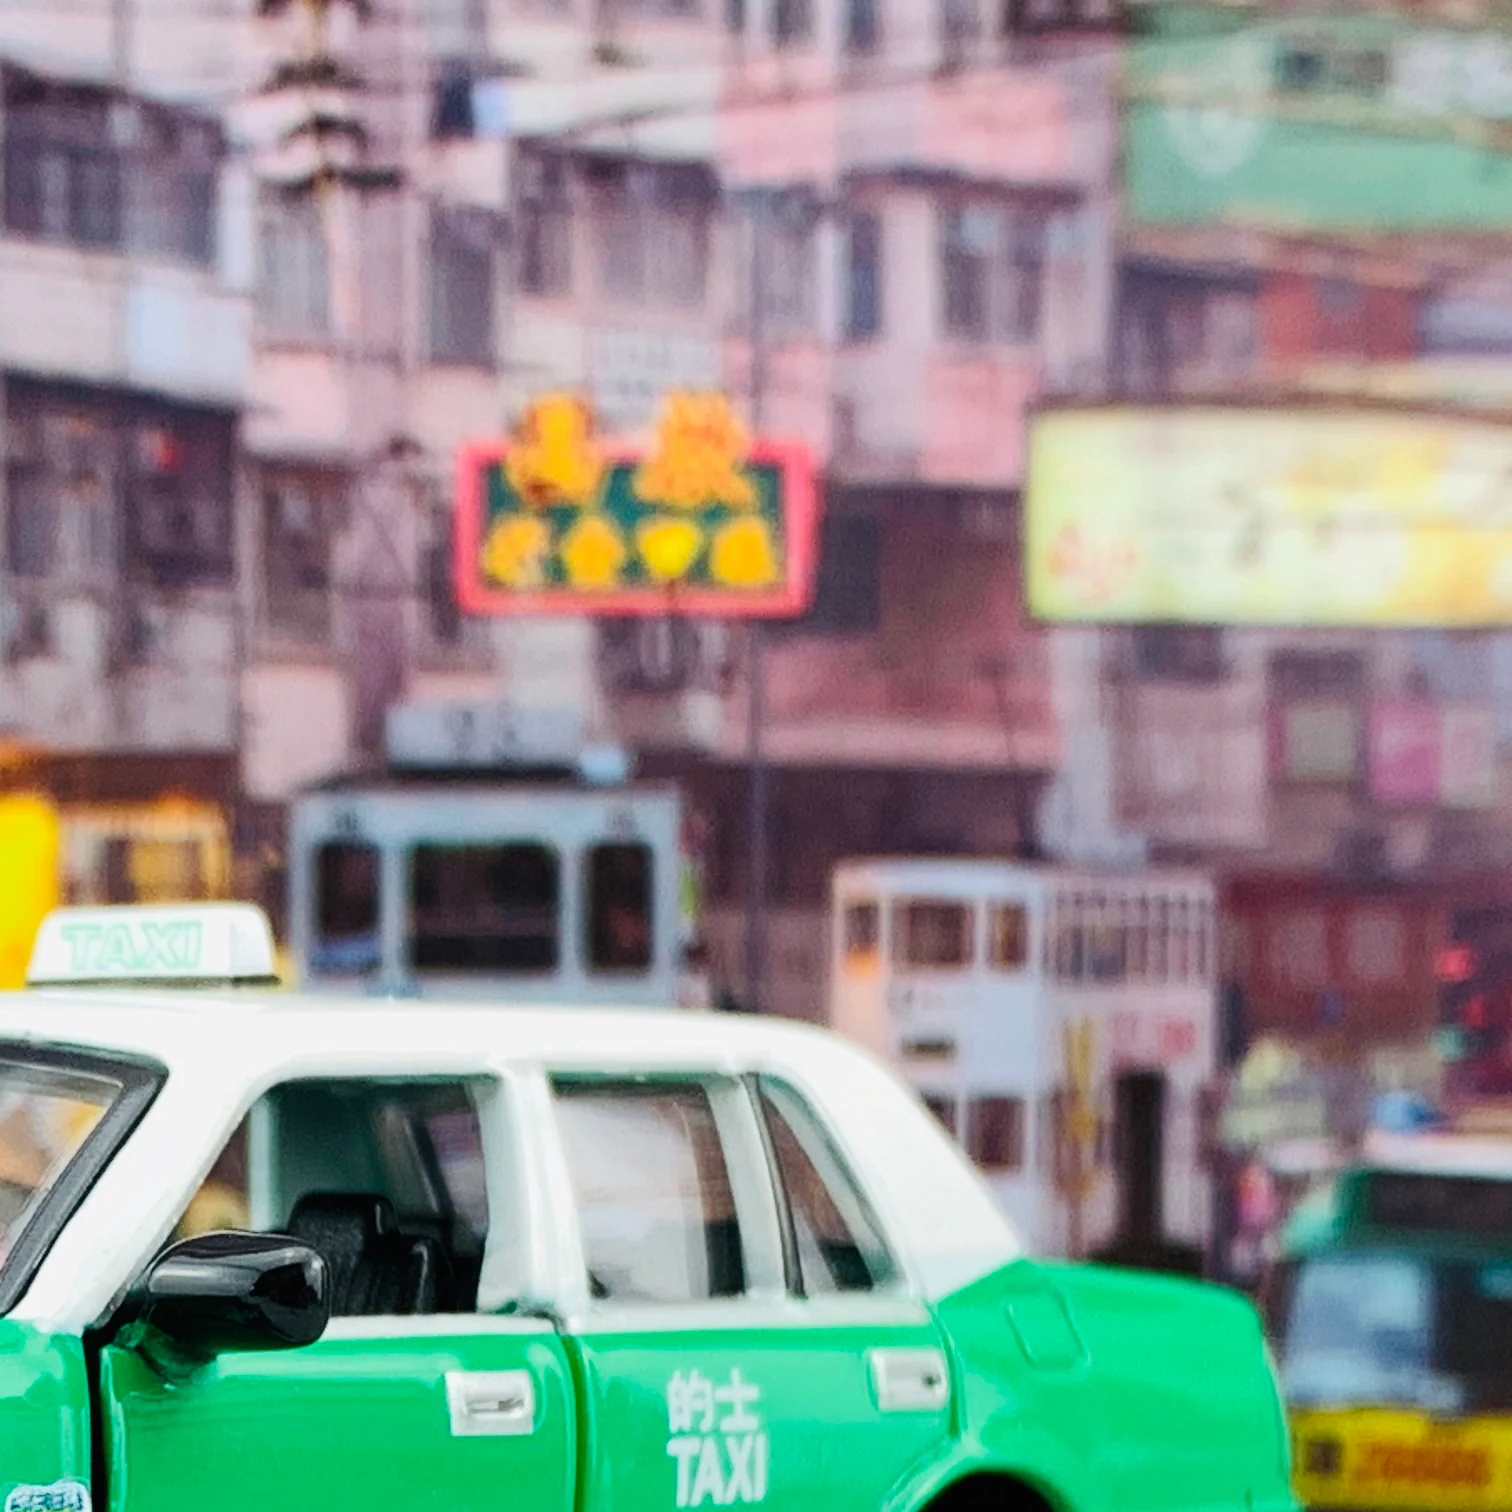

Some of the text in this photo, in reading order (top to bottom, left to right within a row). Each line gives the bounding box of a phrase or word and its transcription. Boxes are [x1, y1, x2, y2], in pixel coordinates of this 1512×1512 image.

[60, 919, 204, 972] TAXI
[666, 1367, 761, 1433] 的士
[666, 1432, 769, 1508] TAXI
